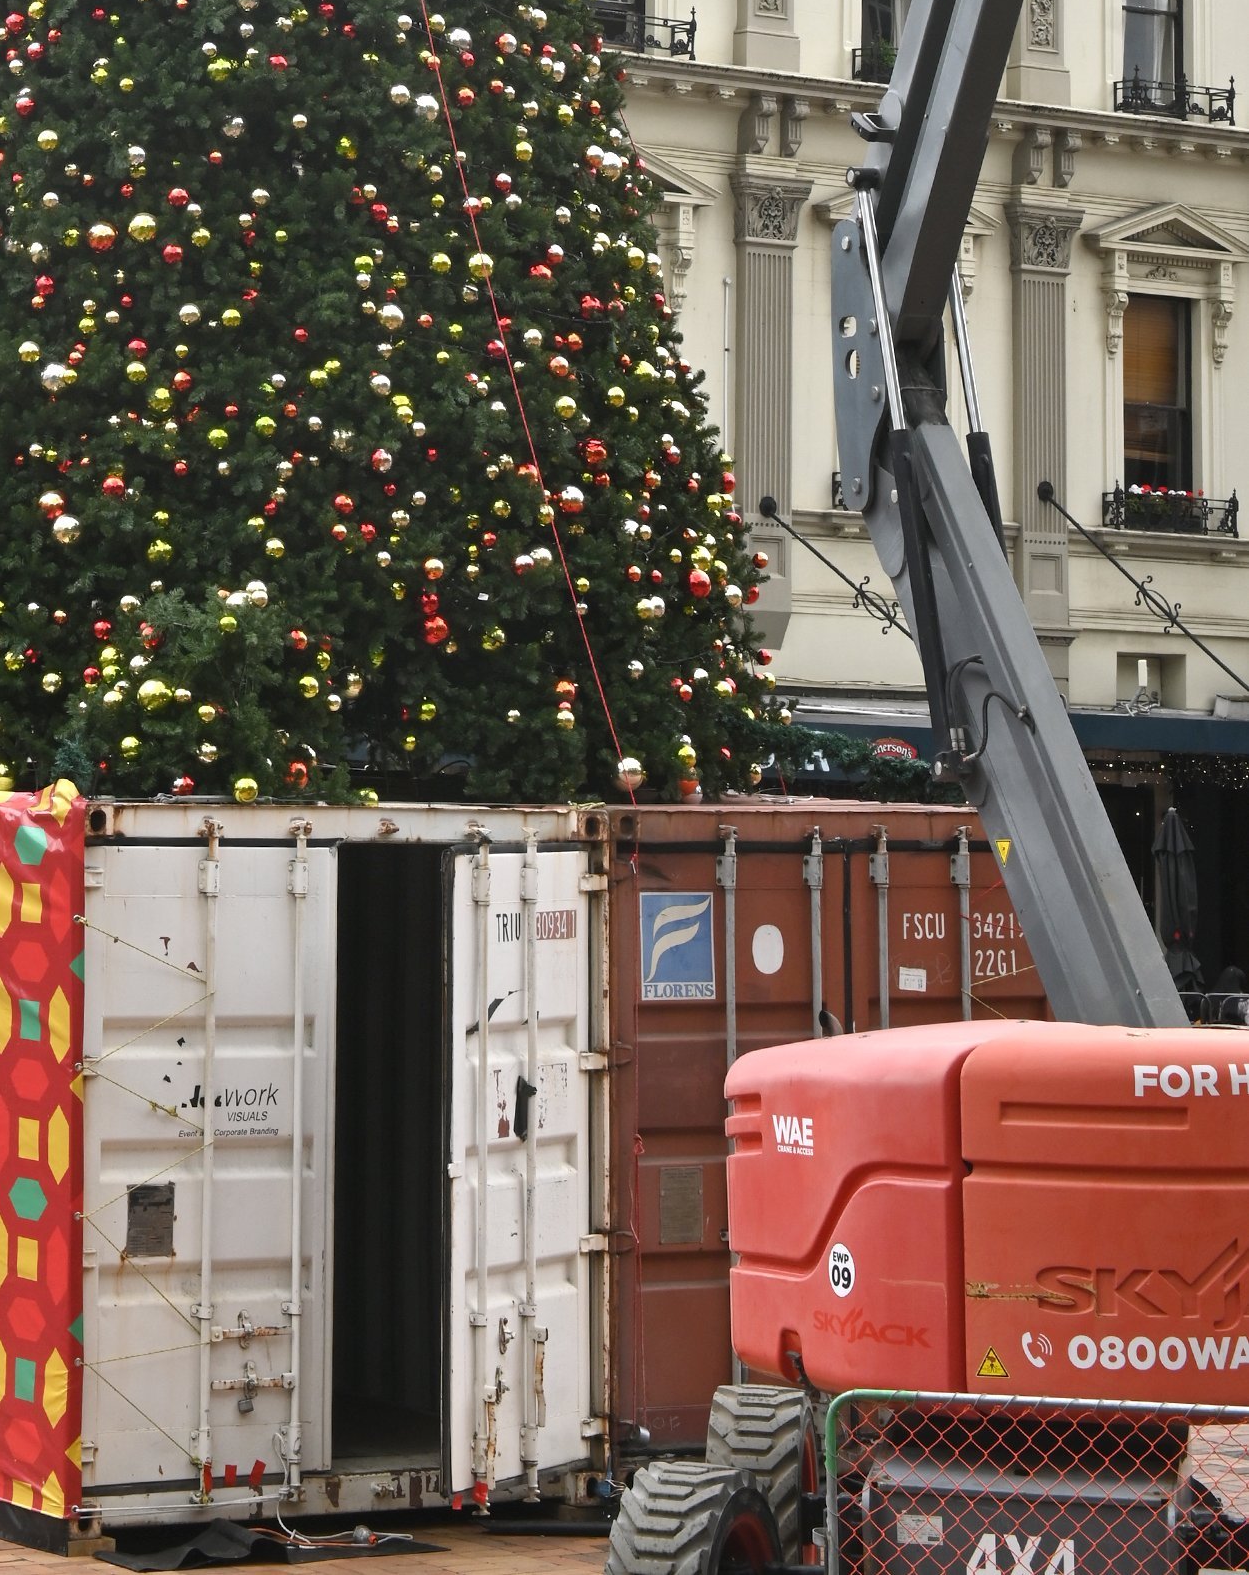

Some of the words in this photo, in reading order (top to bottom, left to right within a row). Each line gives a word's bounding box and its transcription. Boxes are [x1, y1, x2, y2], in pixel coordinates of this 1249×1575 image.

[872, 743, 914, 760] merson's
[496, 912, 521, 943] TRIU
[903, 912, 945, 940] FSCU
[974, 949, 1017, 976] 22G1
[643, 983, 714, 998] FLORENS
[1133, 1064, 1220, 1098] FOR
[227, 1110, 269, 1123] VISUALS
[178, 1129, 198, 1138] Event
[213, 1127, 248, 1138] Corporate
[249, 1127, 279, 1137] Branding
[772, 1114, 814, 1147] WAE
[777, 1144, 793, 1154] CRANE
[796, 1146, 814, 1156] ACCESS
[832, 1251, 850, 1264] EWP
[831, 1264, 852, 1289] 09
[1036, 1237, 1249, 1332] SKYJ
[813, 1307, 933, 1349] SKYJACK
[966, 1533, 1076, 1575] 4X4
